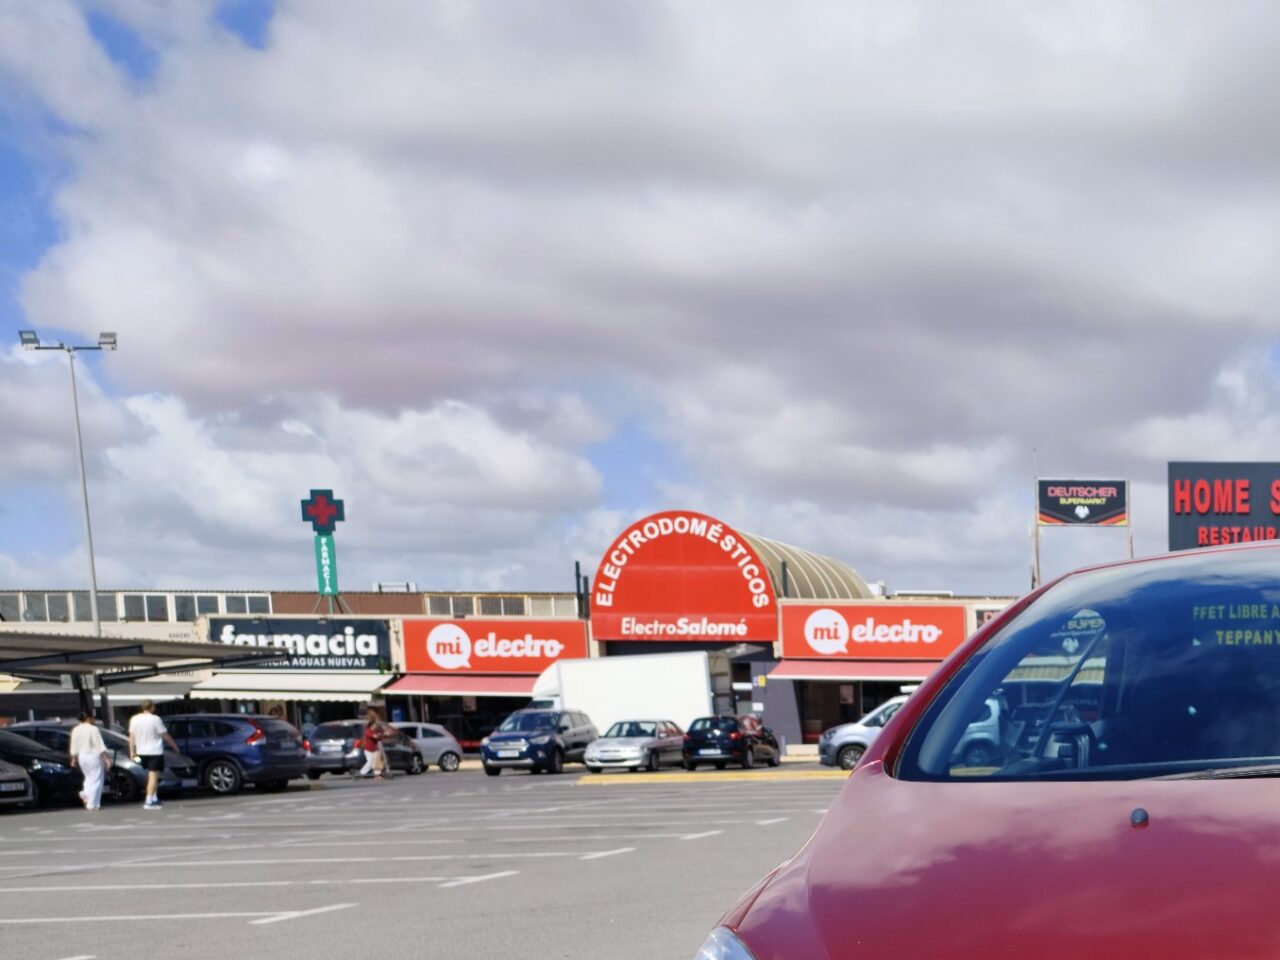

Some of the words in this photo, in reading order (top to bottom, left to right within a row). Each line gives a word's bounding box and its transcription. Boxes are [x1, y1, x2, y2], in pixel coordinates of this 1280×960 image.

[1047, 486, 1117, 497] DEUTSCHER
[1059, 497, 1107, 505] SUPERMARKT
[1174, 479, 1250, 514] HOME
[320, 537, 332, 593] FARMACIA
[596, 516, 770, 609] ELECTRODOMÉSTICOS
[1229, 604, 1268, 619] LIBRE
[1271, 604, 1280, 618] A
[621, 616, 748, 636] ElectroSalomé
[813, 621, 841, 640] mi
[851, 617, 943, 644] electro
[435, 636, 463, 655] mi
[473, 632, 565, 658] electro
[292, 657, 326, 667] AGUAS
[328, 657, 366, 667] NUEVAS
